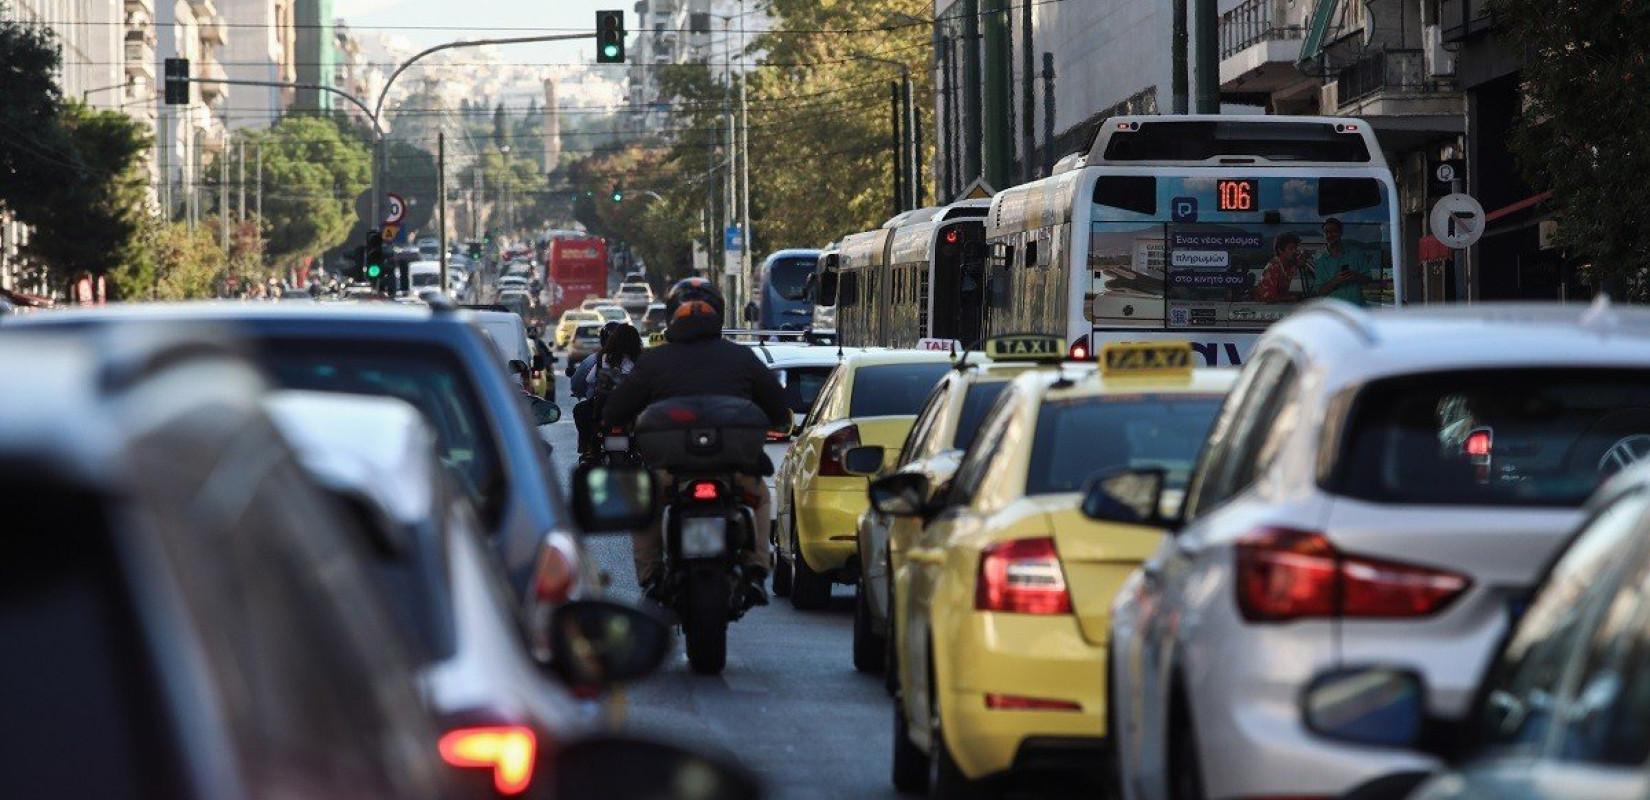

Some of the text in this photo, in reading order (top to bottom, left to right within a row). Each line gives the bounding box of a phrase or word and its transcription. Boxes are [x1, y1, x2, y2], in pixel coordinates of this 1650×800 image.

[1220, 181, 1250, 210] 106
[1225, 235, 1259, 246] κόσμος
[1175, 253, 1224, 263] πληρωμών
[1175, 275, 1244, 284] στο κινητό σου
[1003, 340, 1051, 353] TAXI
[1106, 347, 1187, 369] TAXI
